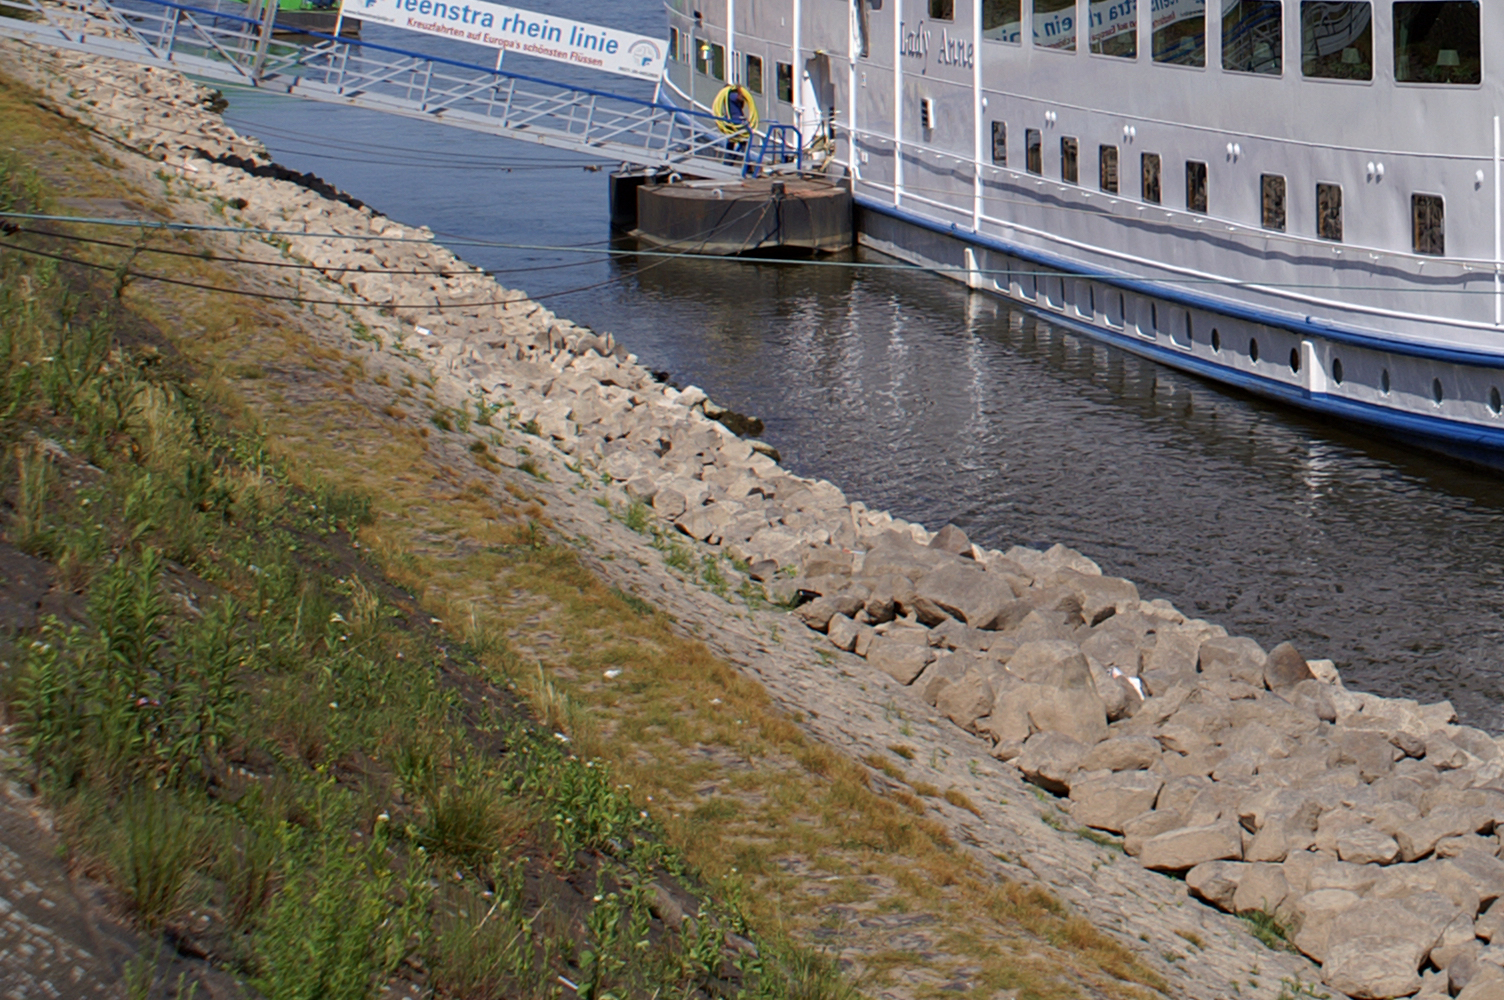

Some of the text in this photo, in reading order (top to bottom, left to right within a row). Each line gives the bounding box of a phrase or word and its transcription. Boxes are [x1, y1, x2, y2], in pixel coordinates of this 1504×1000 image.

[406, 17, 604, 67] Kreuzfahrten auf Europa's schönsten Flüssen
[501, 13, 562, 43] rhein
[569, 25, 619, 55] linie
[900, 19, 974, 75] Lady Anne
